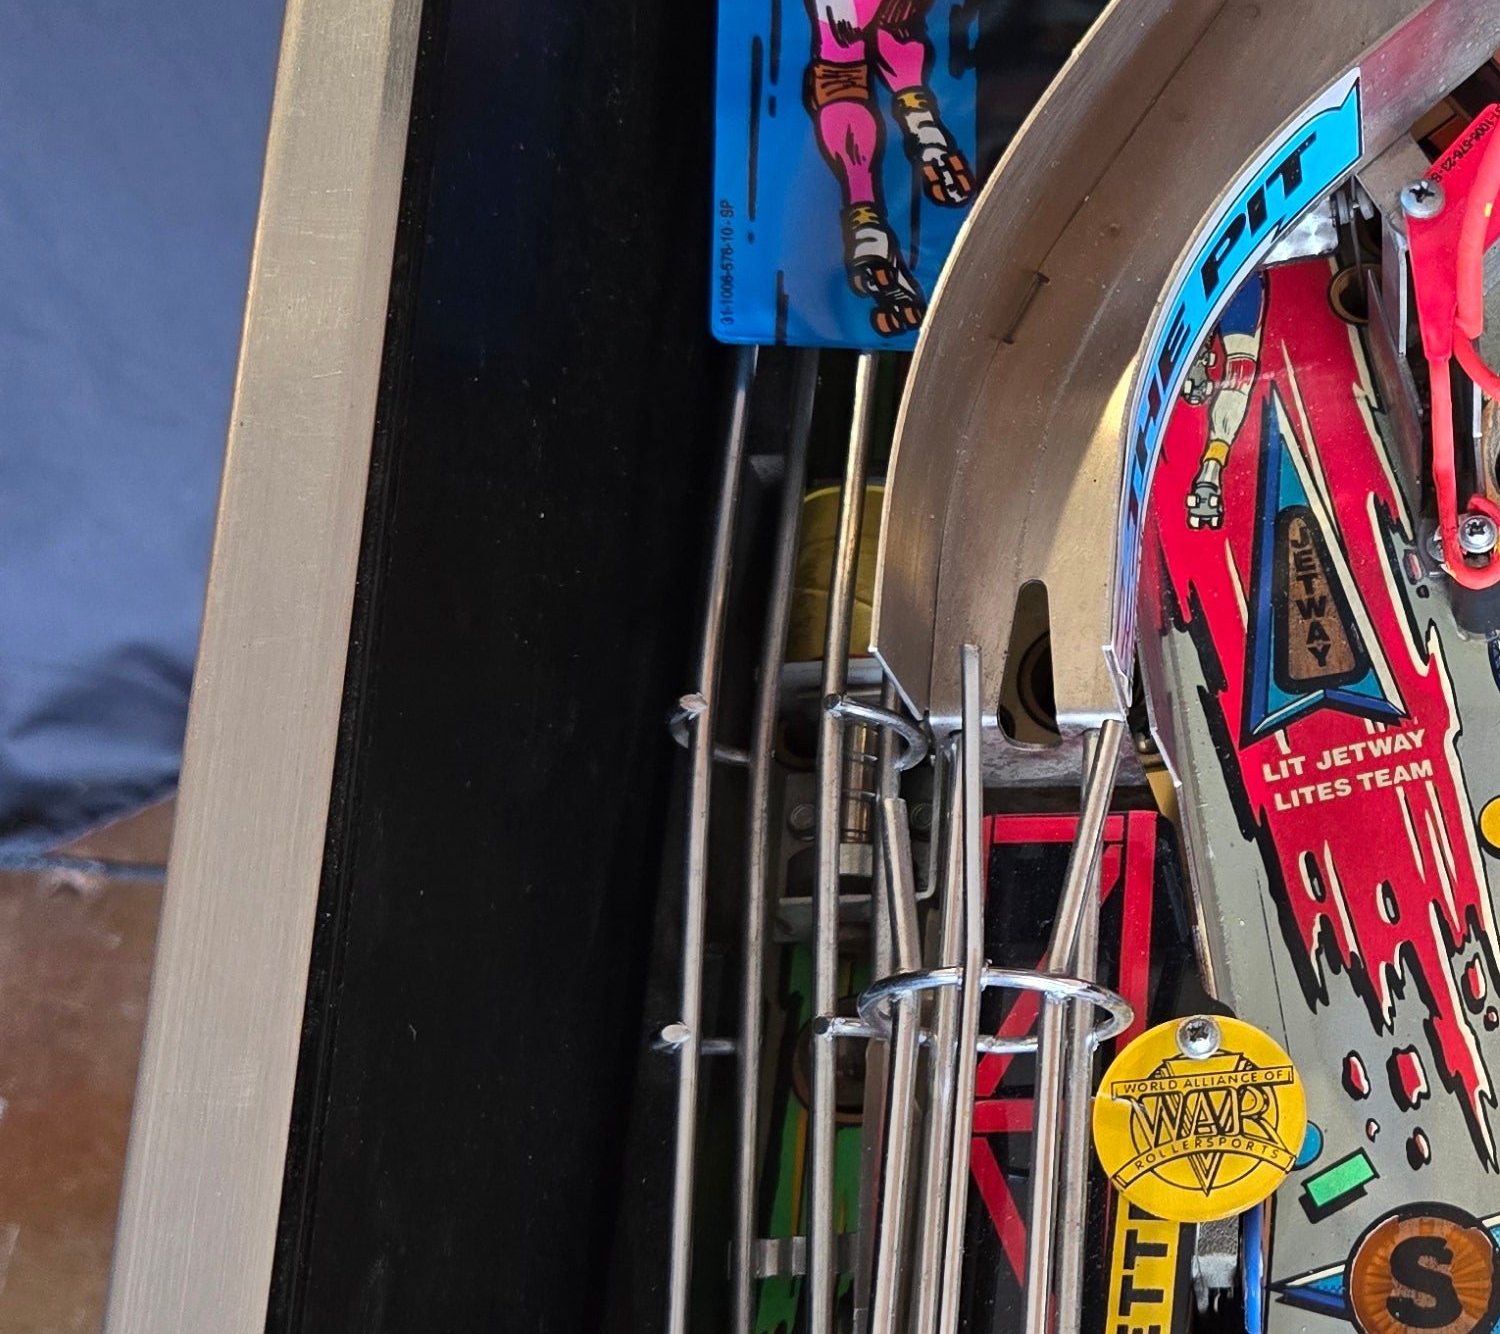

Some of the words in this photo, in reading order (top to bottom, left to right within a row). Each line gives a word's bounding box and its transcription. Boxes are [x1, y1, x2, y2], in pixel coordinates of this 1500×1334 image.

[1128, 300, 1193, 533] THE
[1199, 129, 1318, 303] PIT
[1287, 517, 1334, 666] JETWAY
[1263, 754, 1306, 783] LIT
[1316, 728, 1427, 772] JETWAY
[1273, 777, 1352, 811] LITES
[1356, 757, 1434, 793] TEAM
[1123, 1079, 1178, 1094] WORLD
[1184, 1073, 1257, 1088] ALLIANCE
[1264, 1069, 1283, 1081] OF
[1131, 1085, 1290, 1150] WAR
[1134, 1136, 1280, 1171] ROLLERSPORTS
